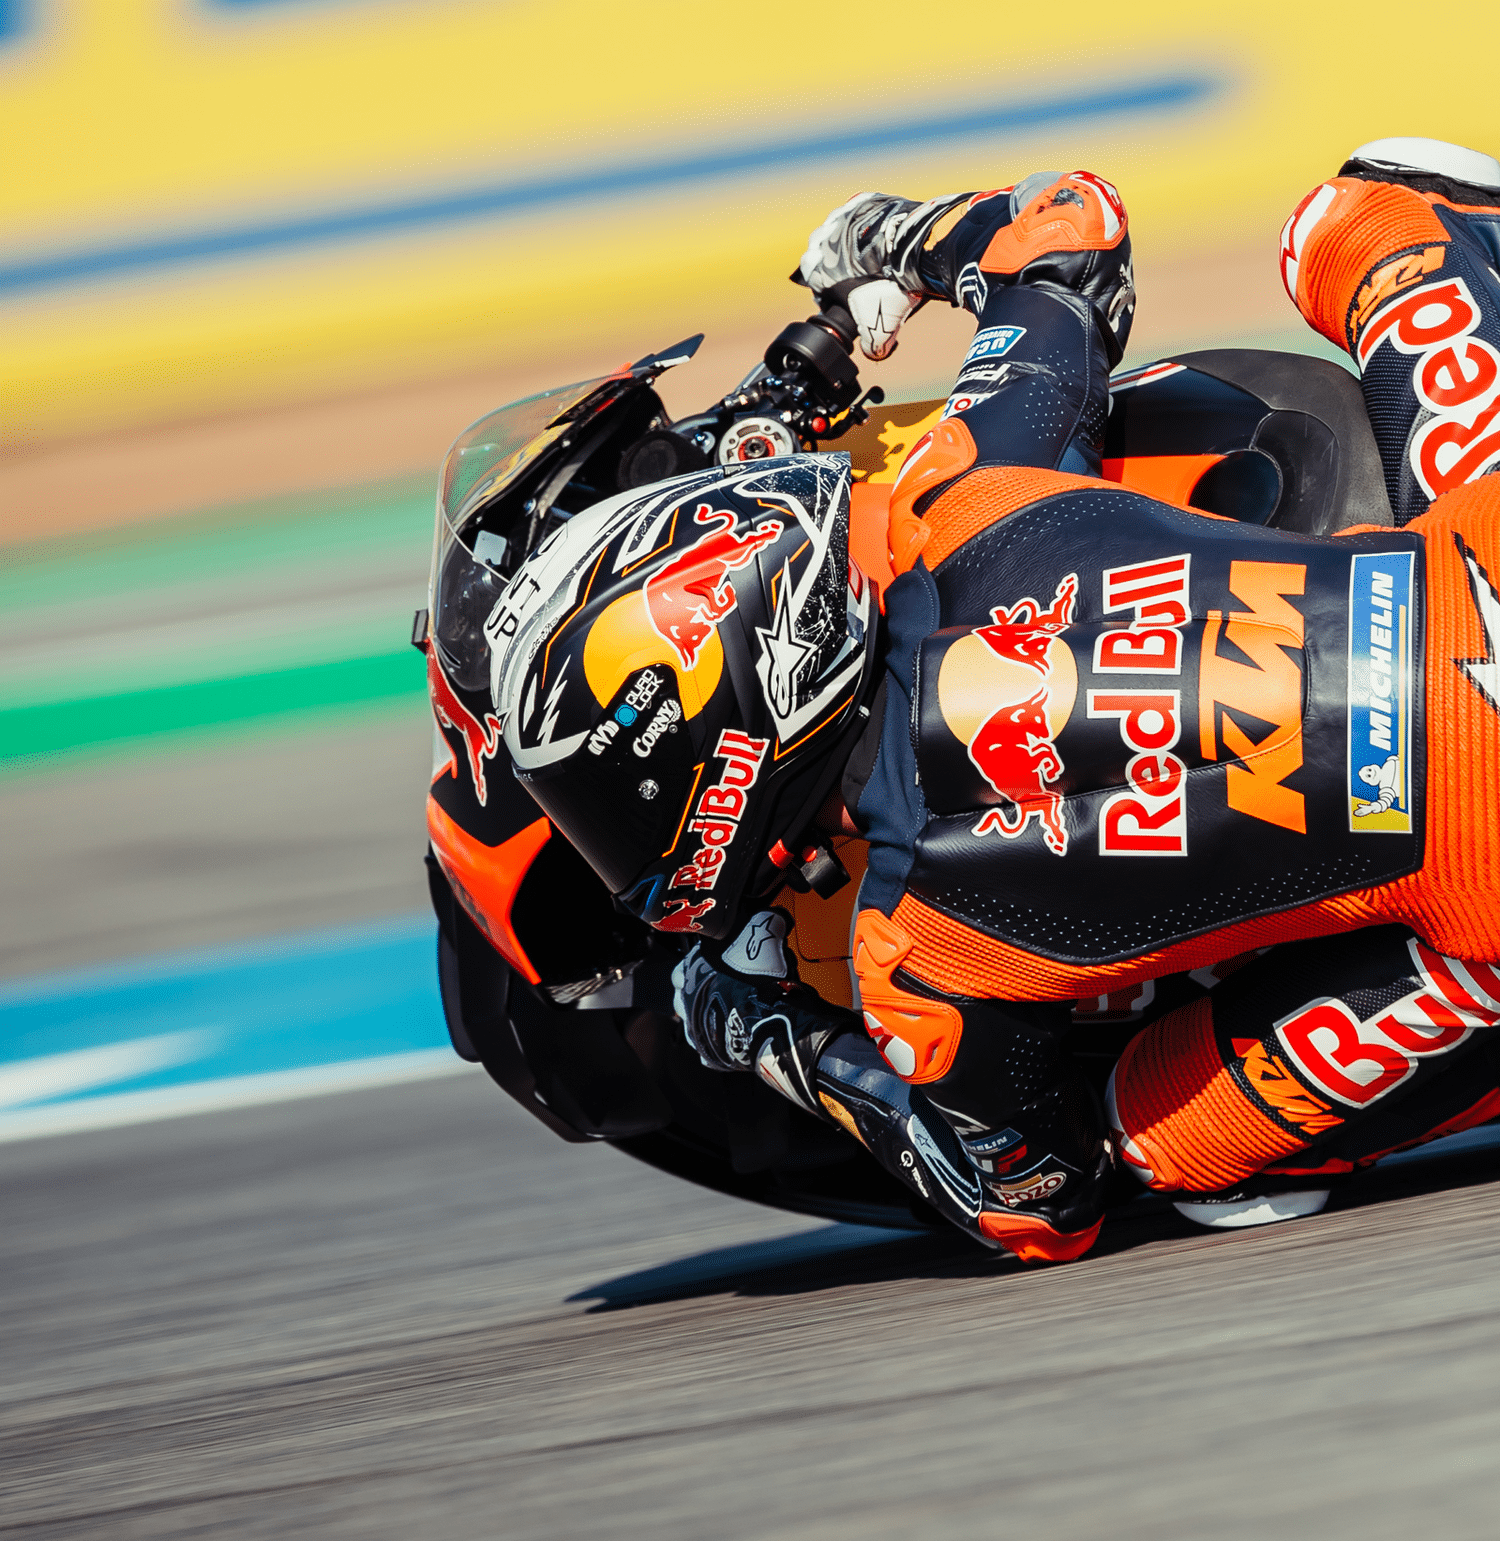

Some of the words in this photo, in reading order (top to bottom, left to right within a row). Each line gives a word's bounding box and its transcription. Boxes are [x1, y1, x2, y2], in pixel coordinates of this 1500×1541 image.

[1349, 246, 1446, 344] KTM
[1092, 553, 1191, 675] Bull
[1369, 571, 1394, 751] MICHELIN
[625, 669, 655, 705] QUAD
[632, 700, 674, 757] CORNY
[633, 675, 665, 711] LOCK
[1199, 560, 1307, 835] KTM
[695, 728, 770, 822] Bull
[1087, 689, 1187, 856] Red
[668, 818, 738, 891] Red
[968, 1136, 1008, 1151] HELIN
